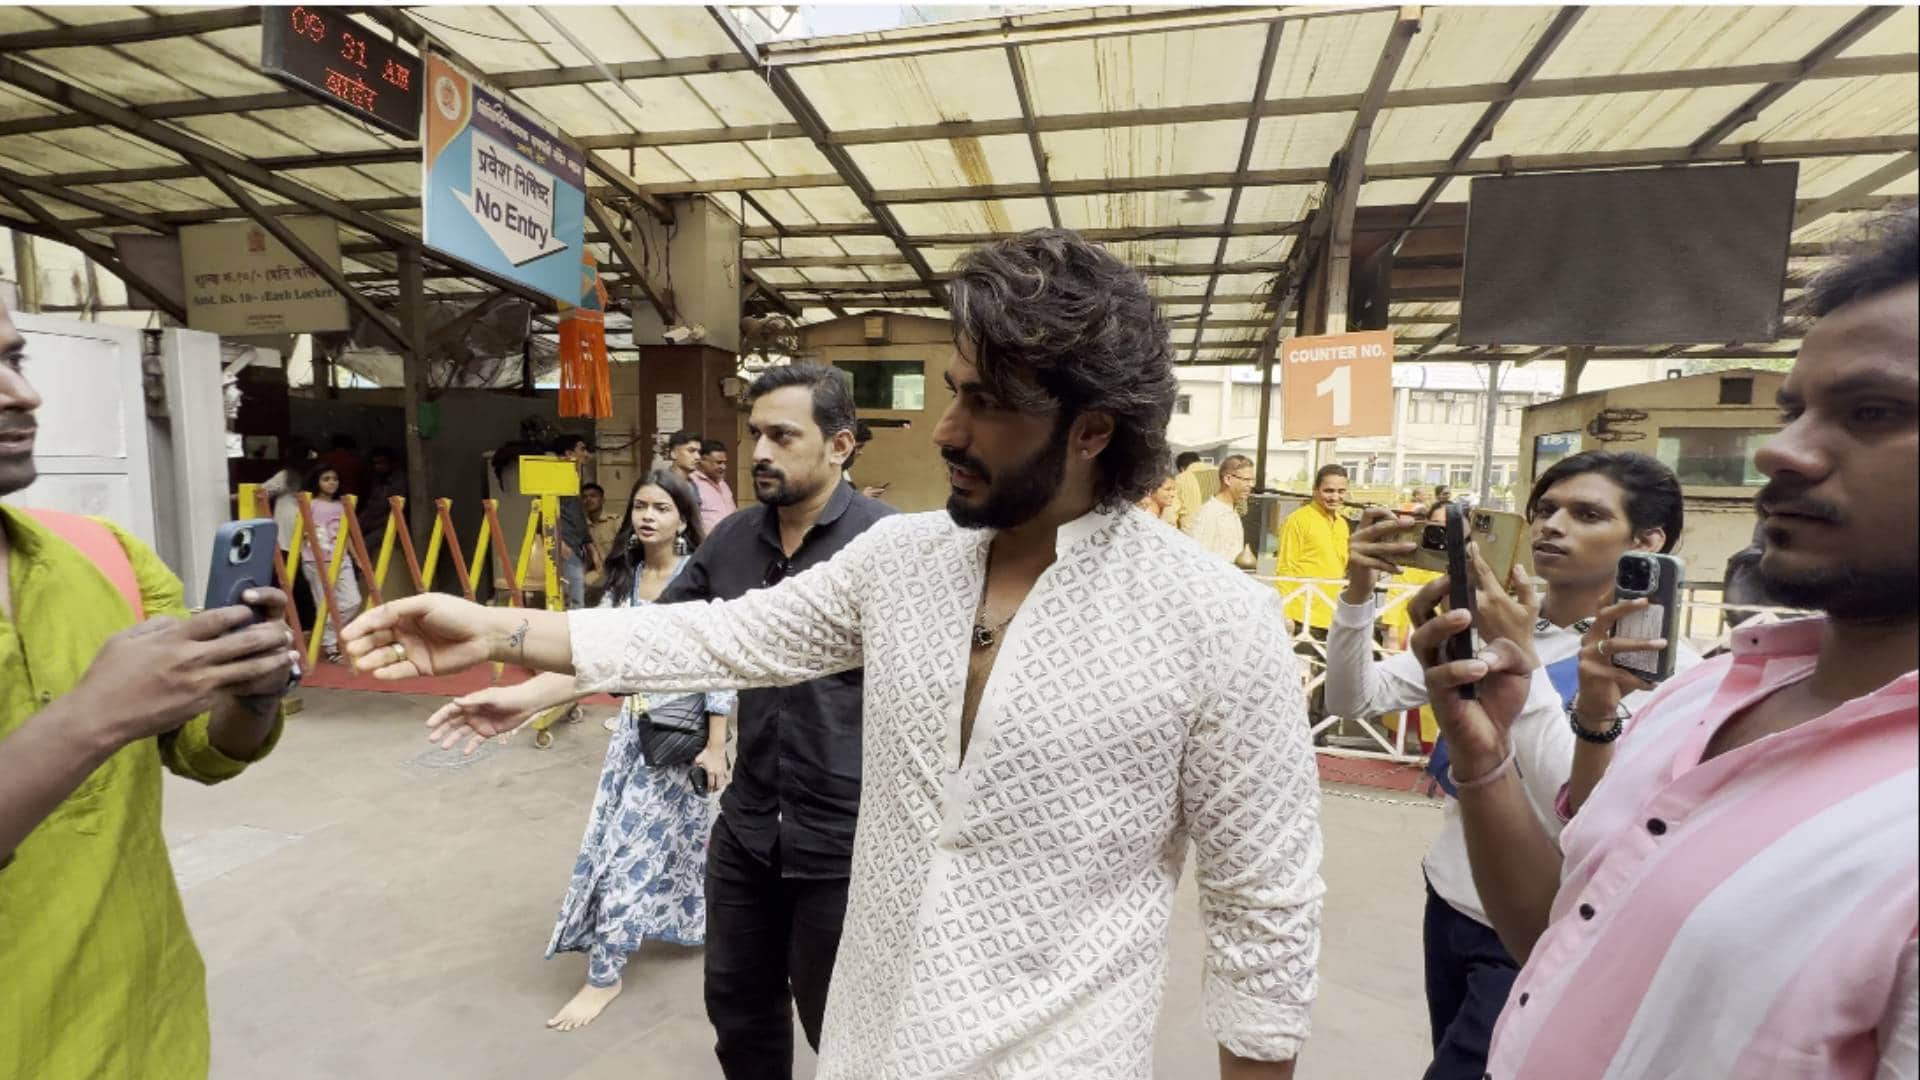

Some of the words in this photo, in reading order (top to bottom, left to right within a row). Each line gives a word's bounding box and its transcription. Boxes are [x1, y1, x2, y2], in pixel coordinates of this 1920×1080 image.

[291, 6, 325, 42] 09
[341, 32, 367, 69] 31
[382, 59, 411, 92] AM
[477, 145, 513, 187] प्रवेश
[476, 187, 501, 222] No
[505, 202, 549, 250] Entry
[1289, 345, 1358, 363] COUNTER
[1360, 343, 1387, 358] NO.
[1316, 364, 1352, 427] 1
